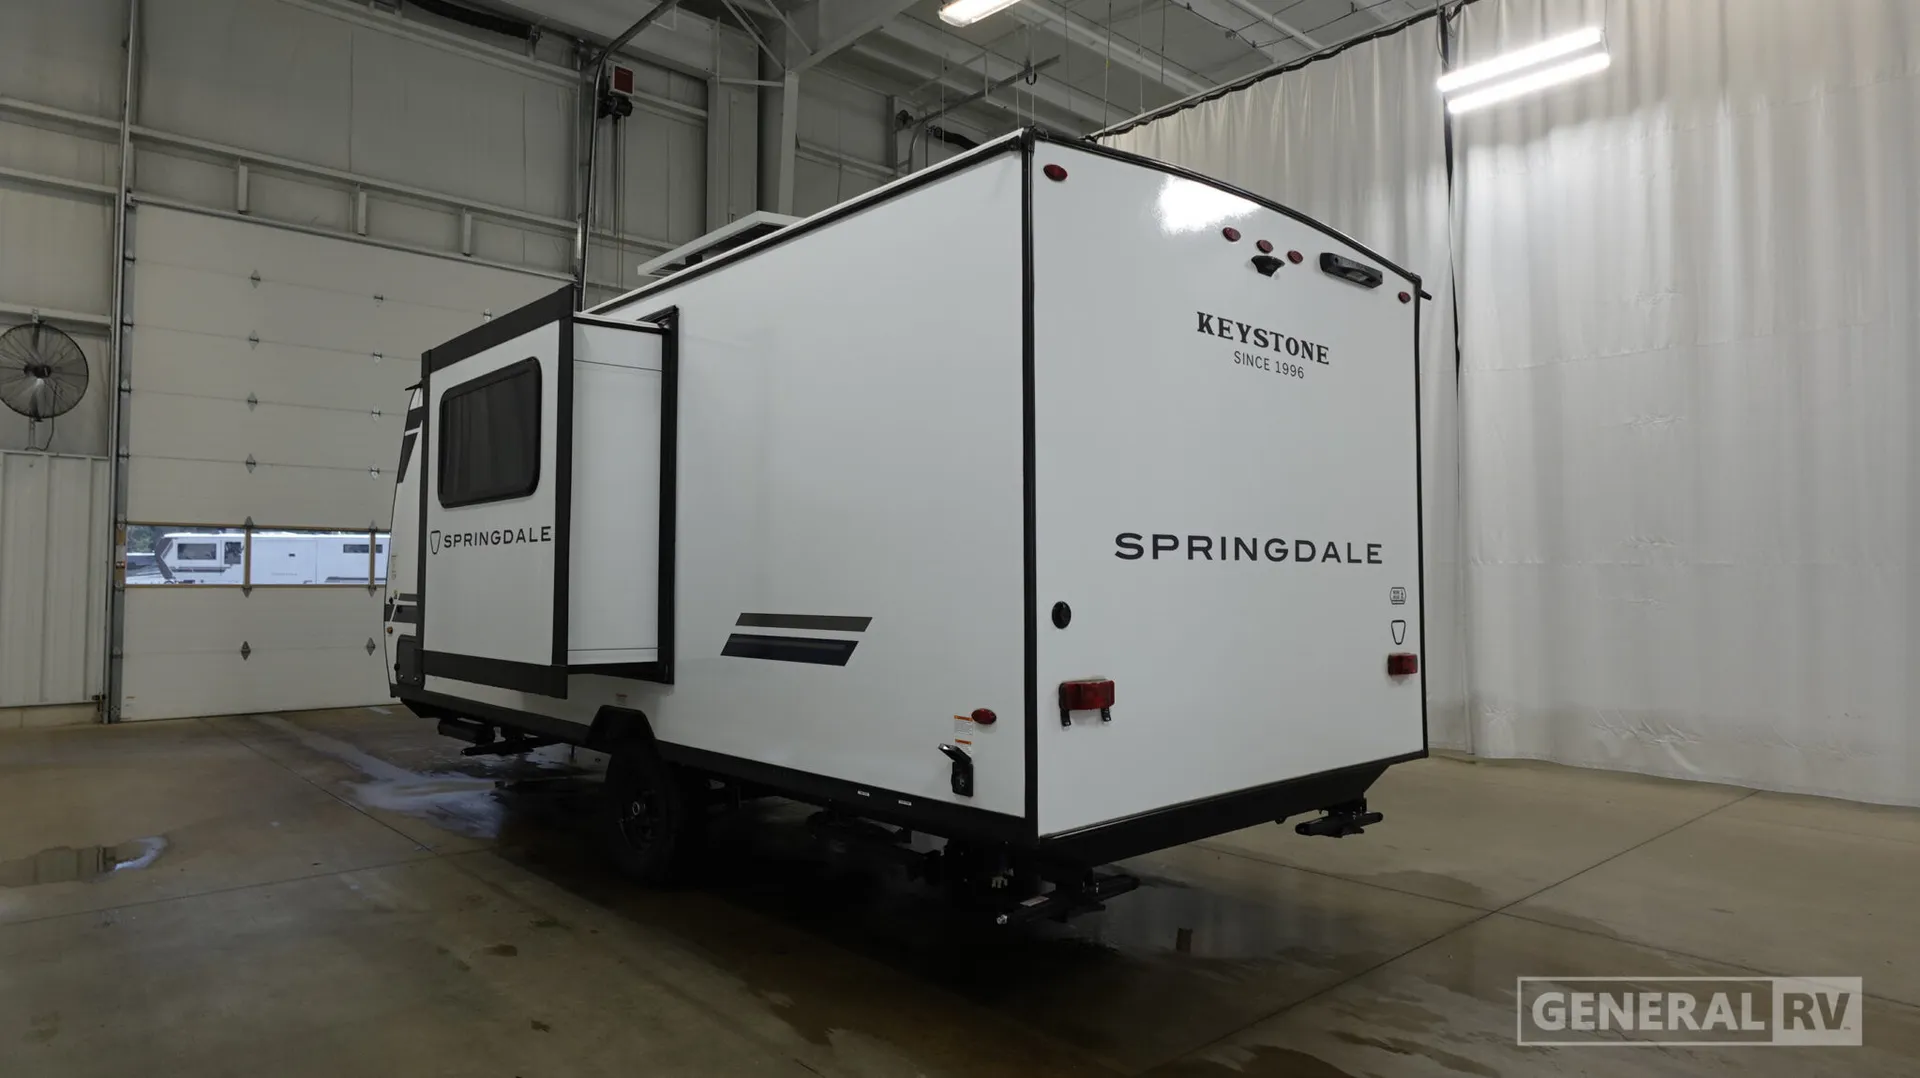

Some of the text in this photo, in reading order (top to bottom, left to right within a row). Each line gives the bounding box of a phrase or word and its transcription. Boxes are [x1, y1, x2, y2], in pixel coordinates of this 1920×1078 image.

[1196, 311, 1330, 365] KEYSTONE
[1233, 350, 1305, 379] SINCE 1996
[444, 526, 551, 548] SPRINGDALE
[1114, 532, 1383, 564] SPRINGDALE
